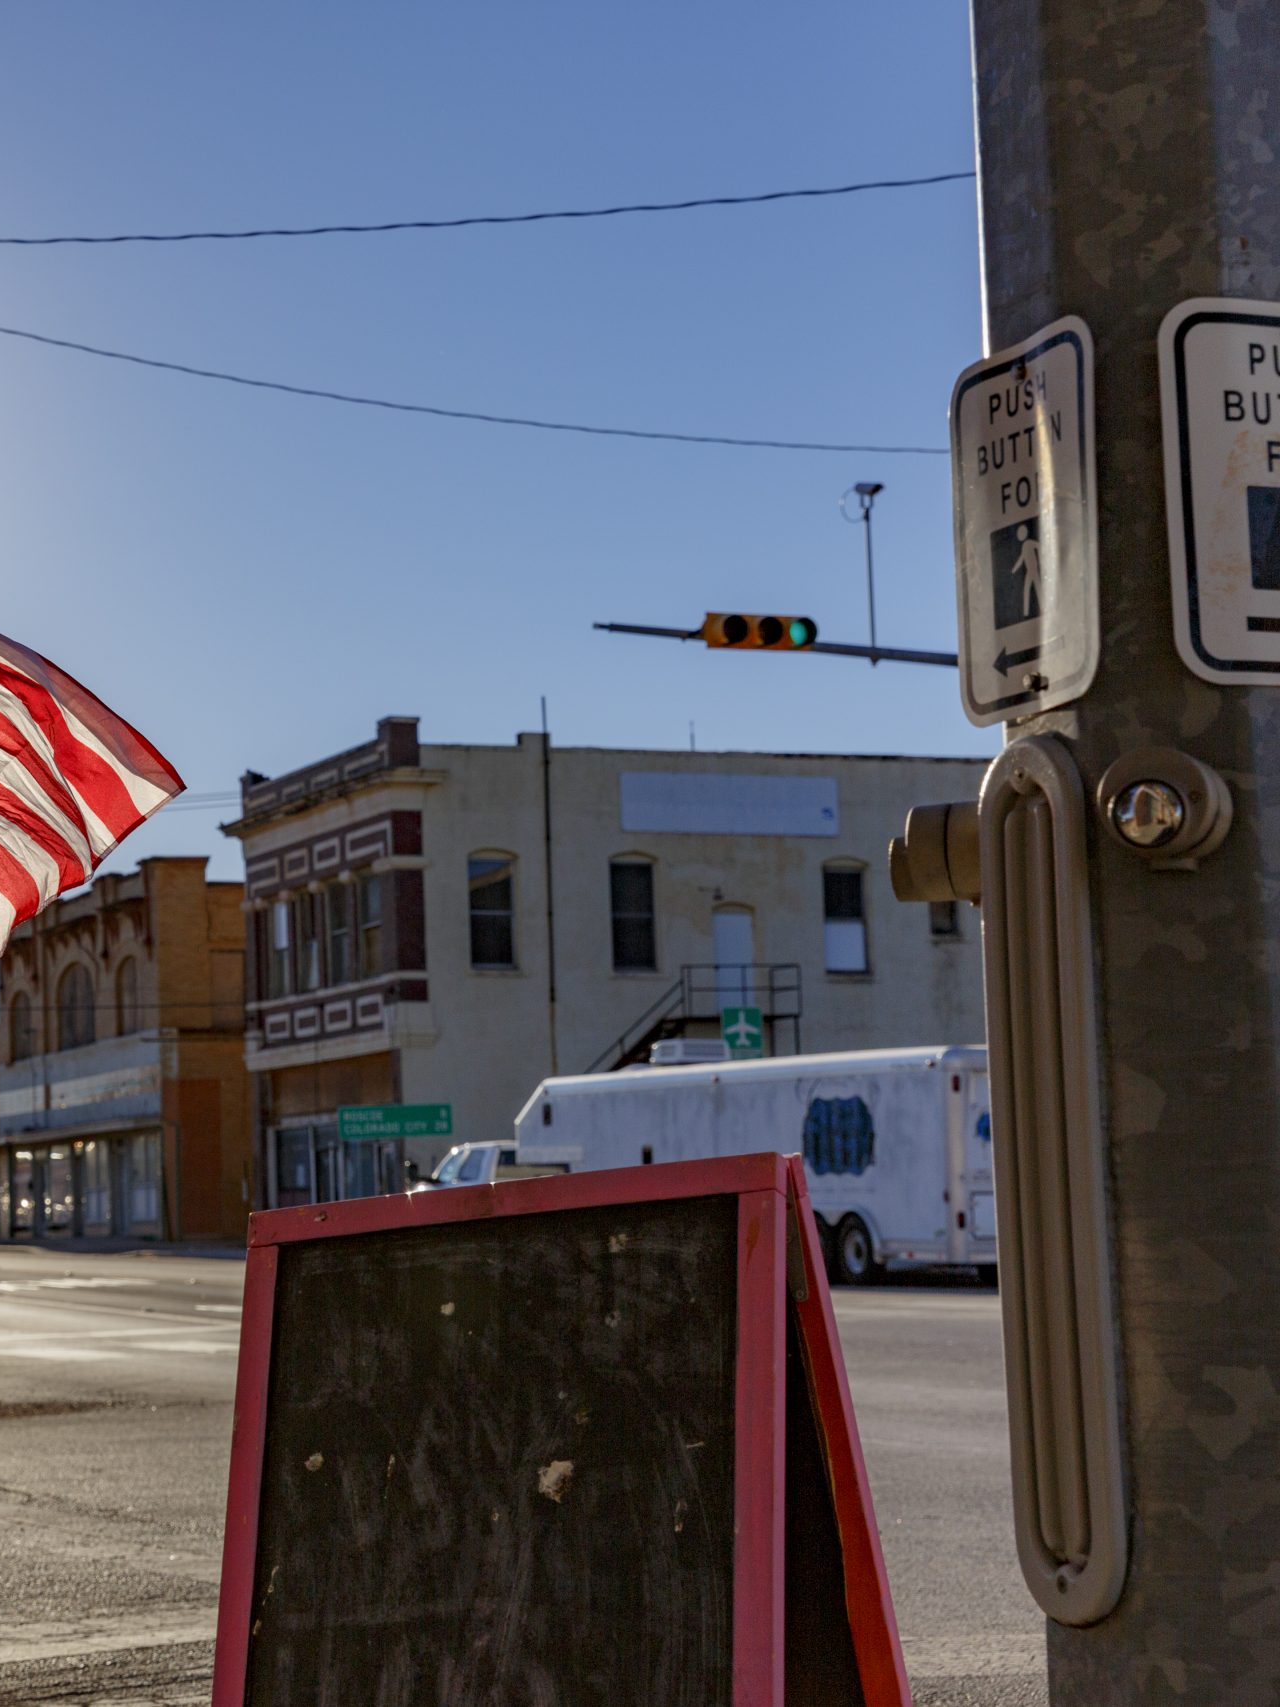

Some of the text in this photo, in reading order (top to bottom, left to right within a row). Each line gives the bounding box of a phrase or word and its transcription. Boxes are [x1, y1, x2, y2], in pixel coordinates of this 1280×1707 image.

[988, 371, 1046, 425] PUSH
[977, 411, 1061, 476] BUTTN
[1001, 473, 1040, 515] FO
[343, 1122, 400, 1135] COLORADO
[405, 1121, 427, 1133] CITY
